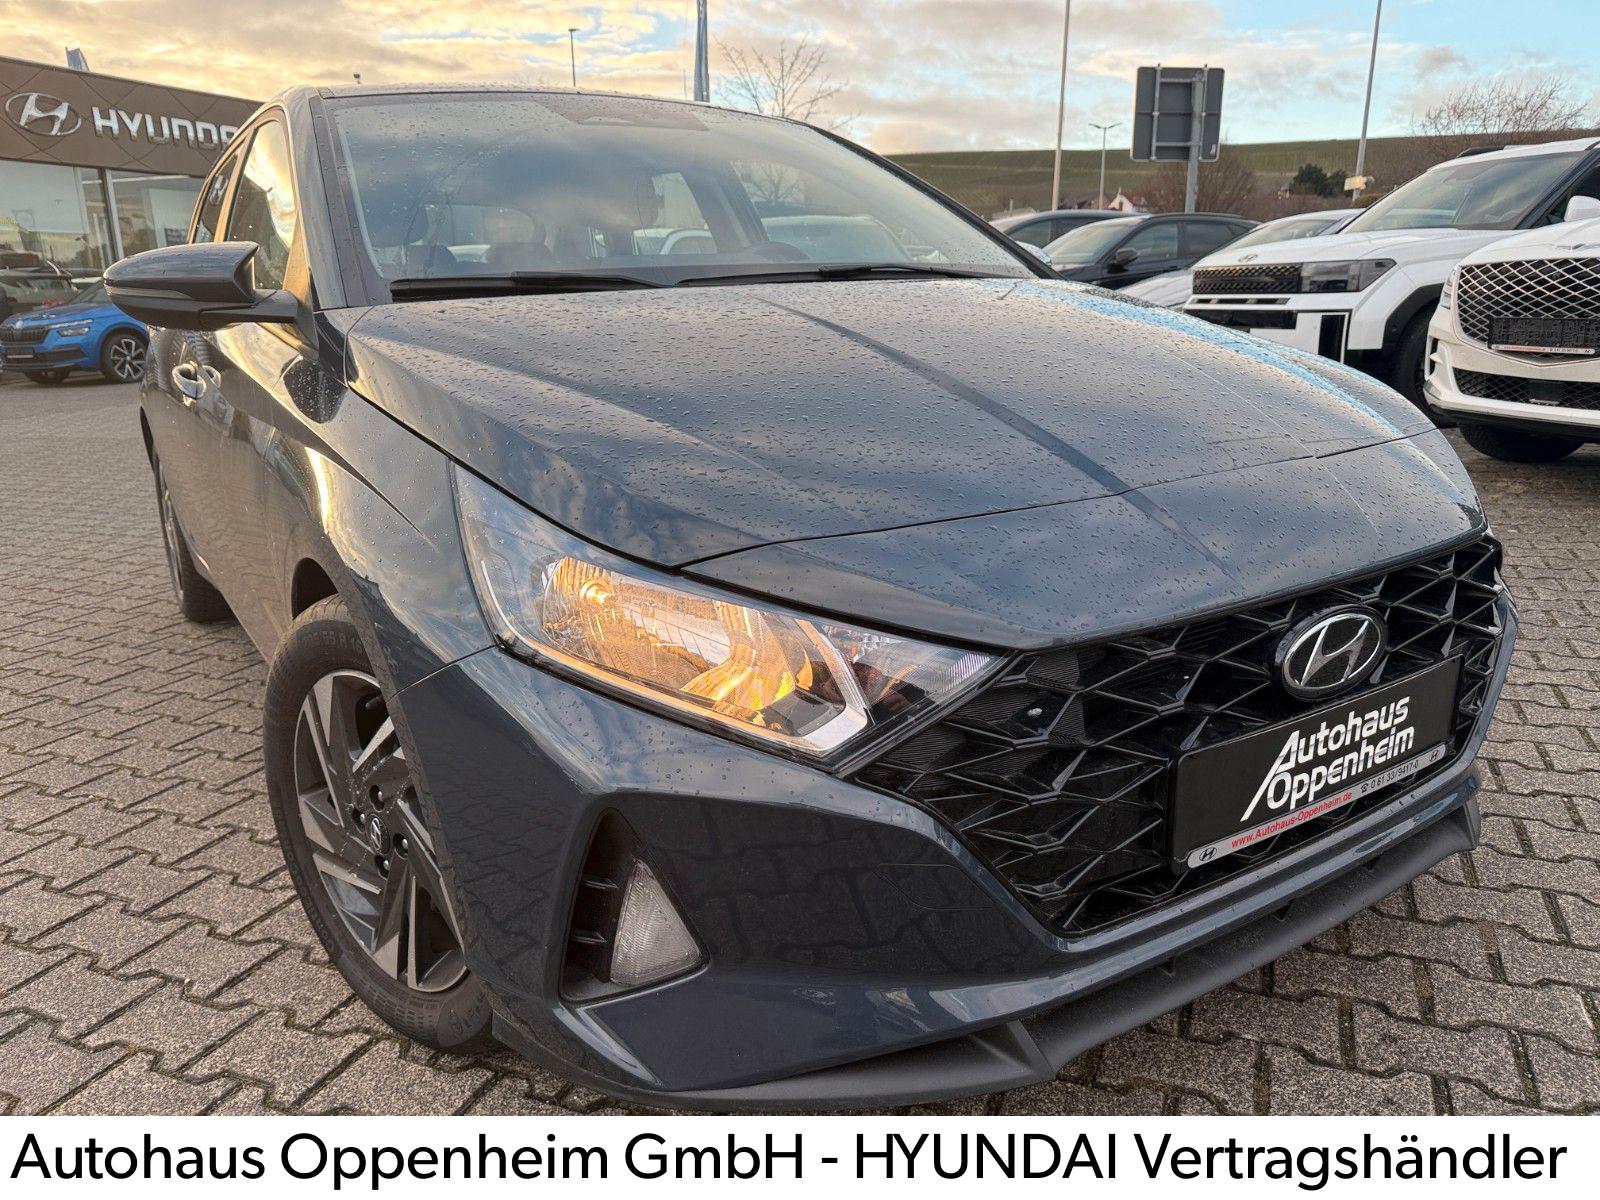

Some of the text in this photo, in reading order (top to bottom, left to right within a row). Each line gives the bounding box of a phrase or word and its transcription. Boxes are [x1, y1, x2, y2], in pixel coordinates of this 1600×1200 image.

[92, 106, 240, 151] HYUNDA
[1240, 696, 1410, 821] Autohaus
[1267, 726, 1415, 810] Oppenheim
[1231, 792, 1353, 848] www.Autohaus-Oppenheim.de
